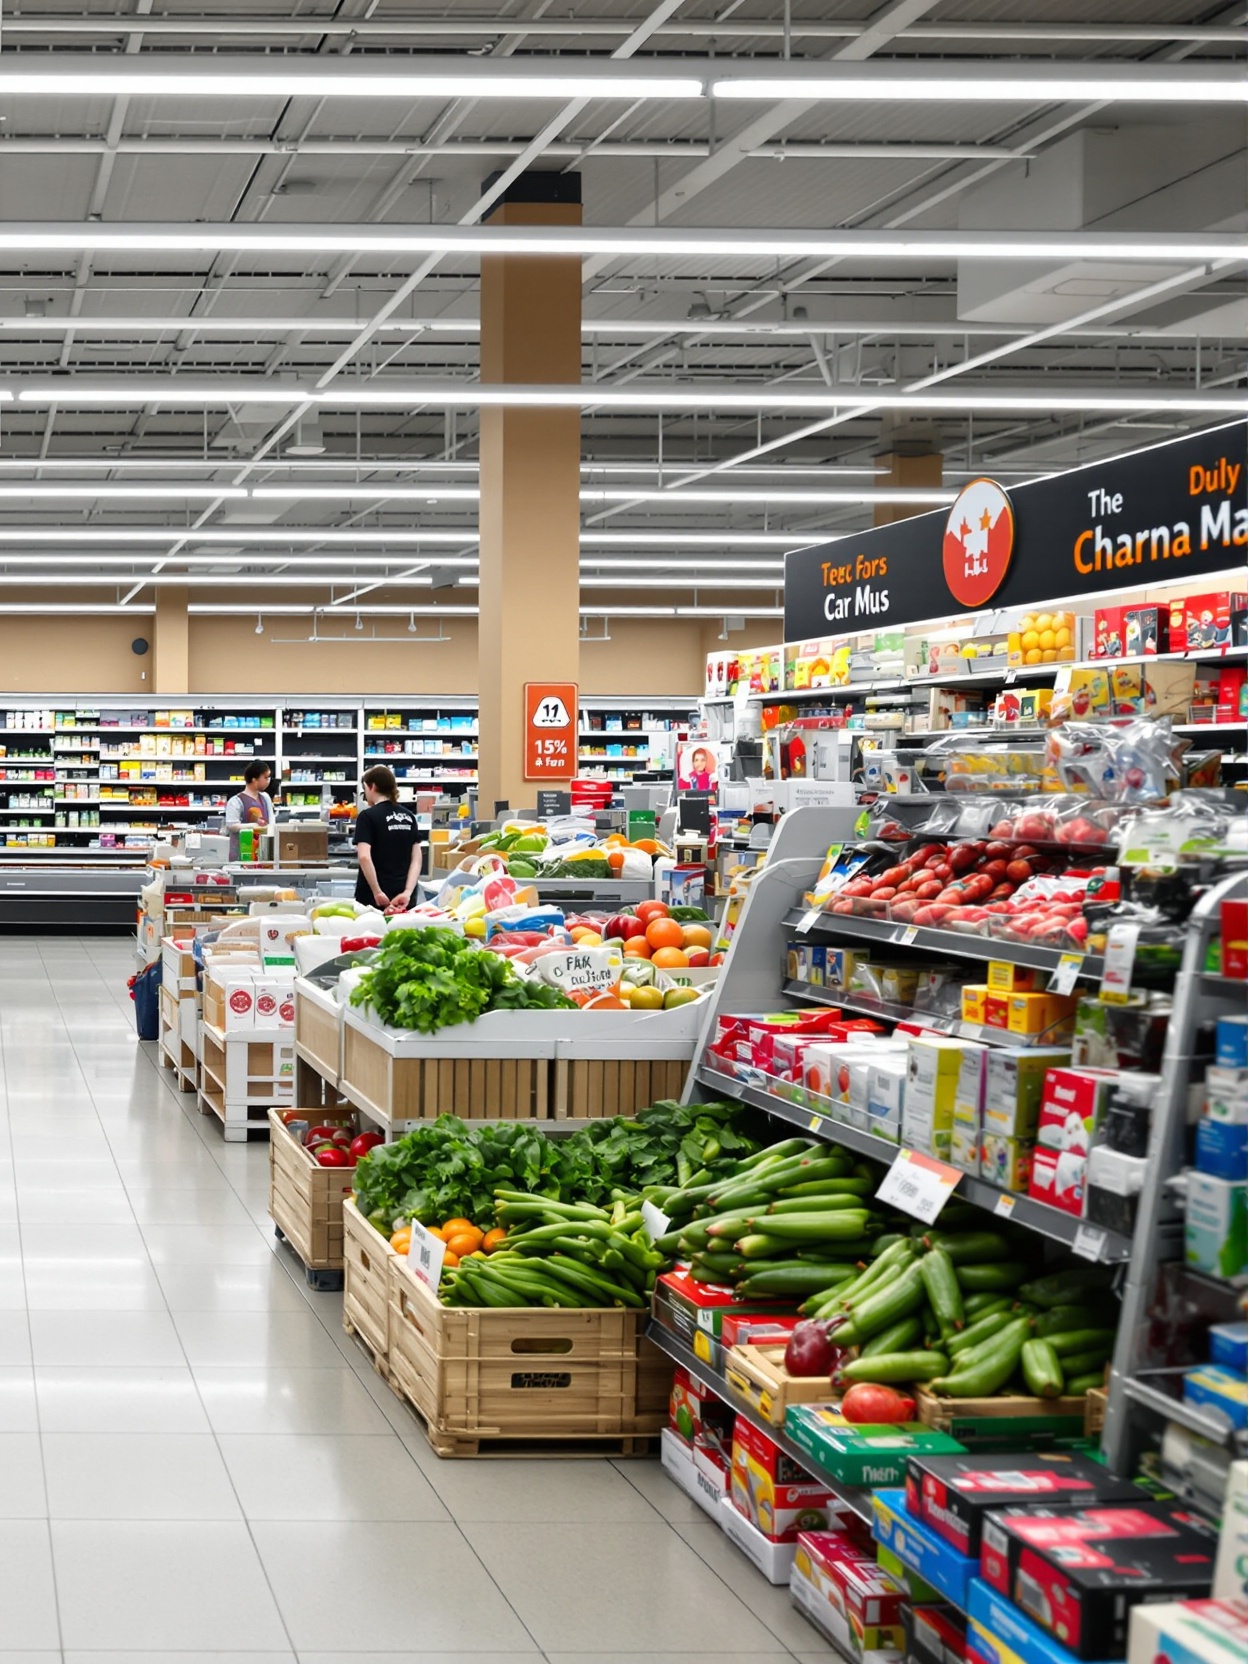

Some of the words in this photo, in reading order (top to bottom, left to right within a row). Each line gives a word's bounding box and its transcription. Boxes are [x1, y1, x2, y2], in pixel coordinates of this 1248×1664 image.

[1087, 488, 1123, 518] The
[1189, 457, 1241, 496] Duly
[1073, 525, 1192, 574] Charna
[824, 593, 852, 621] Car
[855, 584, 890, 616] Mus
[534, 739, 568, 754] 15%
